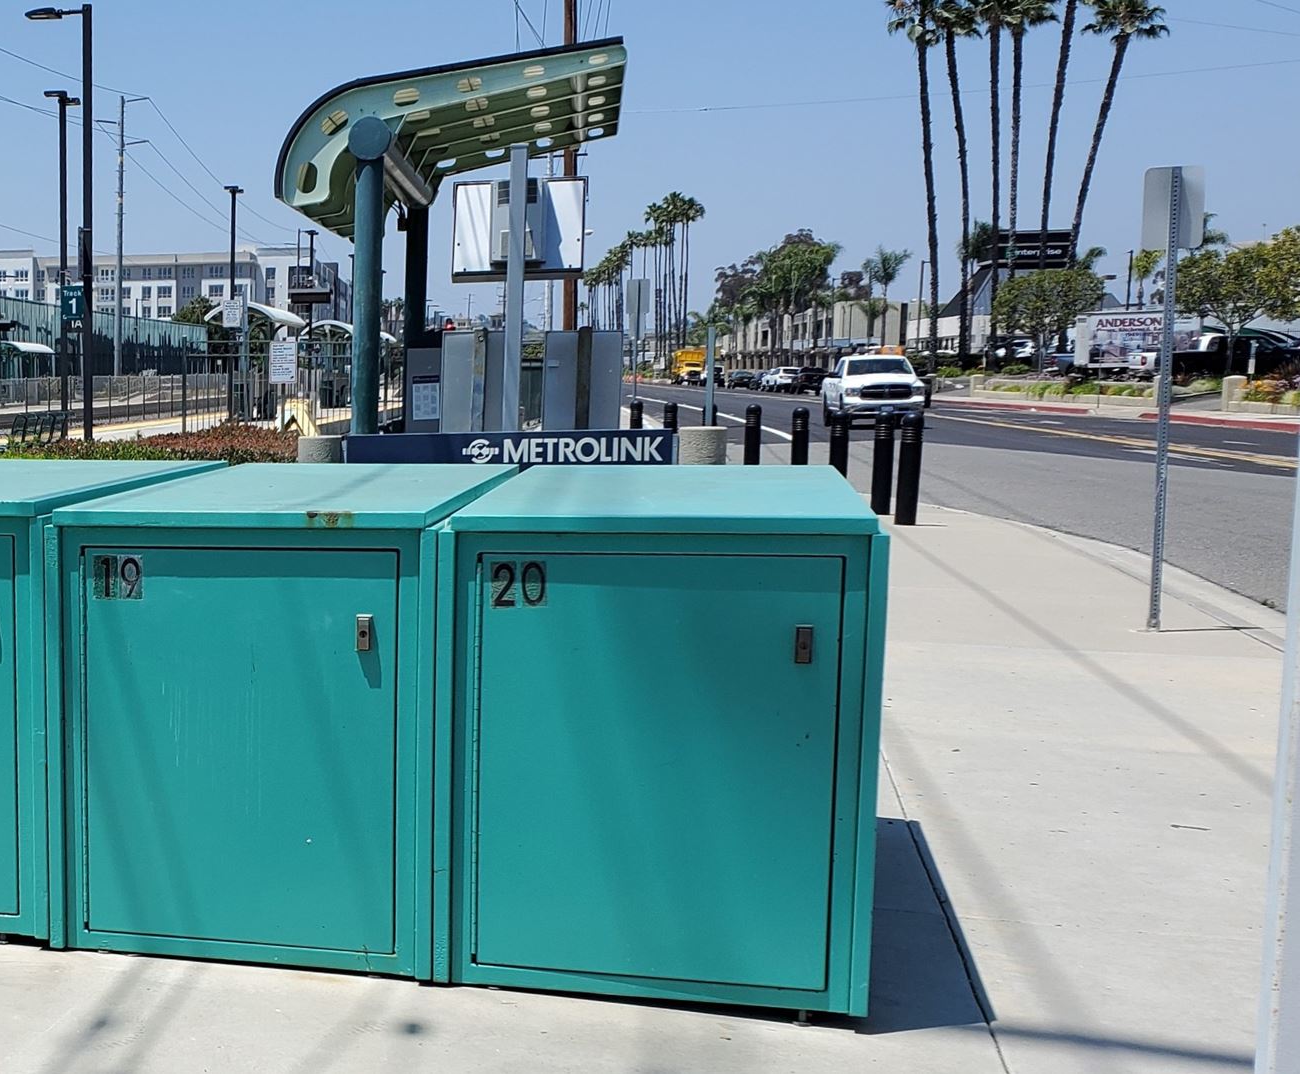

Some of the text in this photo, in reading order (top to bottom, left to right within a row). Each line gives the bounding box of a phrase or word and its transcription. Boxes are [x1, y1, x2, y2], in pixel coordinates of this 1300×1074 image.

[68, 297, 77, 314] 1
[1096, 317, 1162, 328] ANDERSON
[503, 436, 664, 463] METROLINK
[100, 557, 141, 597] 19
[493, 562, 546, 607] 20
